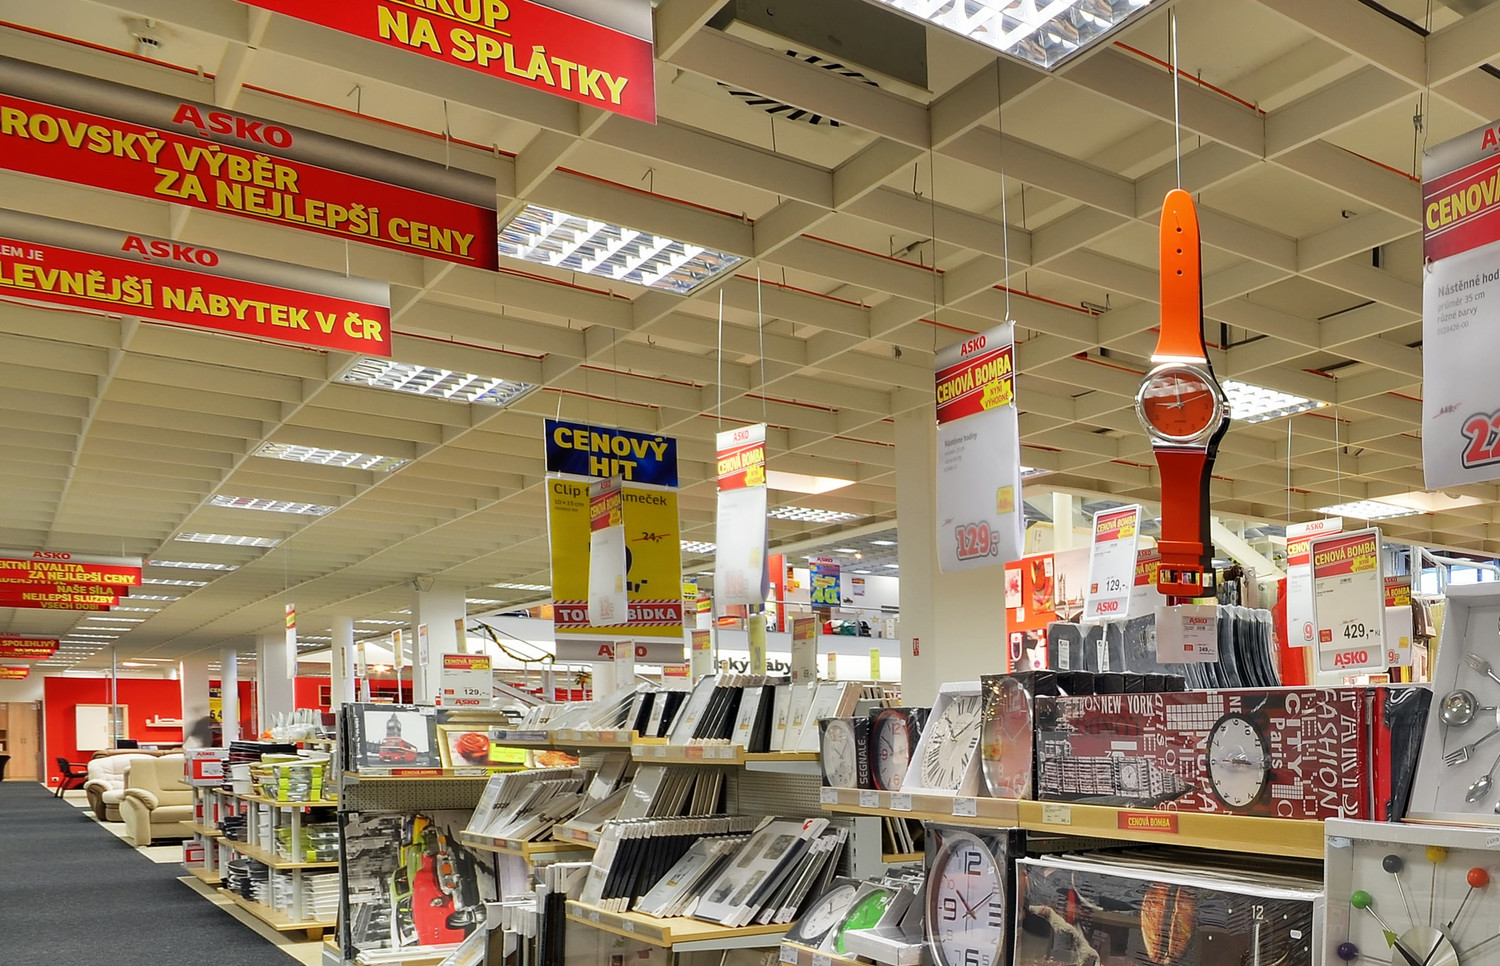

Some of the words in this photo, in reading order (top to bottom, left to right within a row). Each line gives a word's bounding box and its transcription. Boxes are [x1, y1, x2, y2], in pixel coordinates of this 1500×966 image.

[378, 5, 442, 54] NA
[450, 28, 628, 105] SPLÁTKY
[171, 103, 293, 149] ASKO
[1, 106, 165, 164] ROVSKÝ
[174, 143, 299, 194] VÝBĚR
[154, 168, 207, 203] ZA
[216, 180, 379, 236] NEJLEPŠÍ
[388, 214, 474, 257] CENY
[28, 250, 44, 261] JE
[121, 236, 219, 267] ASKO
[1438, 274, 1480, 298] Nástěnné
[1465, 293, 1473, 304] 35
[1474, 291, 1485, 301] cm
[163, 286, 309, 330] NÁBYTEK
[314, 311, 336, 334] V
[343, 310, 383, 342] ČR
[1458, 305, 1478, 320] barvy
[961, 335, 987, 357] ASKO
[937, 367, 973, 404] CENOVÁ
[975, 353, 1011, 388] BOMBA
[554, 427, 668, 462] CENOVÝ
[734, 429, 749, 441] ASKO
[590, 457, 637, 480] HIT
[554, 483, 581, 498] Clip
[1305, 521, 1324, 532] ASKO
[33, 551, 71, 560] ASKO
[1315, 546, 1346, 566] CENOVÁ
[1348, 541, 1376, 560] BOMBA
[29, 570, 45, 579] ZA
[48, 571, 101, 582] NEJLEPŠÍ
[104, 573, 135, 584] CENY
[34, 562, 84, 572] KVALITA
[57, 584, 86, 593] NAŠE
[1096, 600, 1118, 613] ASKO
[1344, 623, 1374, 640] 429,-
[1334, 650, 1368, 669] ASKO
[1101, 695, 1121, 714] NEW
[1127, 694, 1154, 714] YORK
[1270, 717, 1286, 769] Paris
[1285, 692, 1303, 778] CITY
[1316, 688, 1339, 810] FASHION
[1128, 815, 1149, 826] CENOVÁ
[1150, 817, 1170, 827] BOMBA
[1251, 904, 1264, 921] 12
